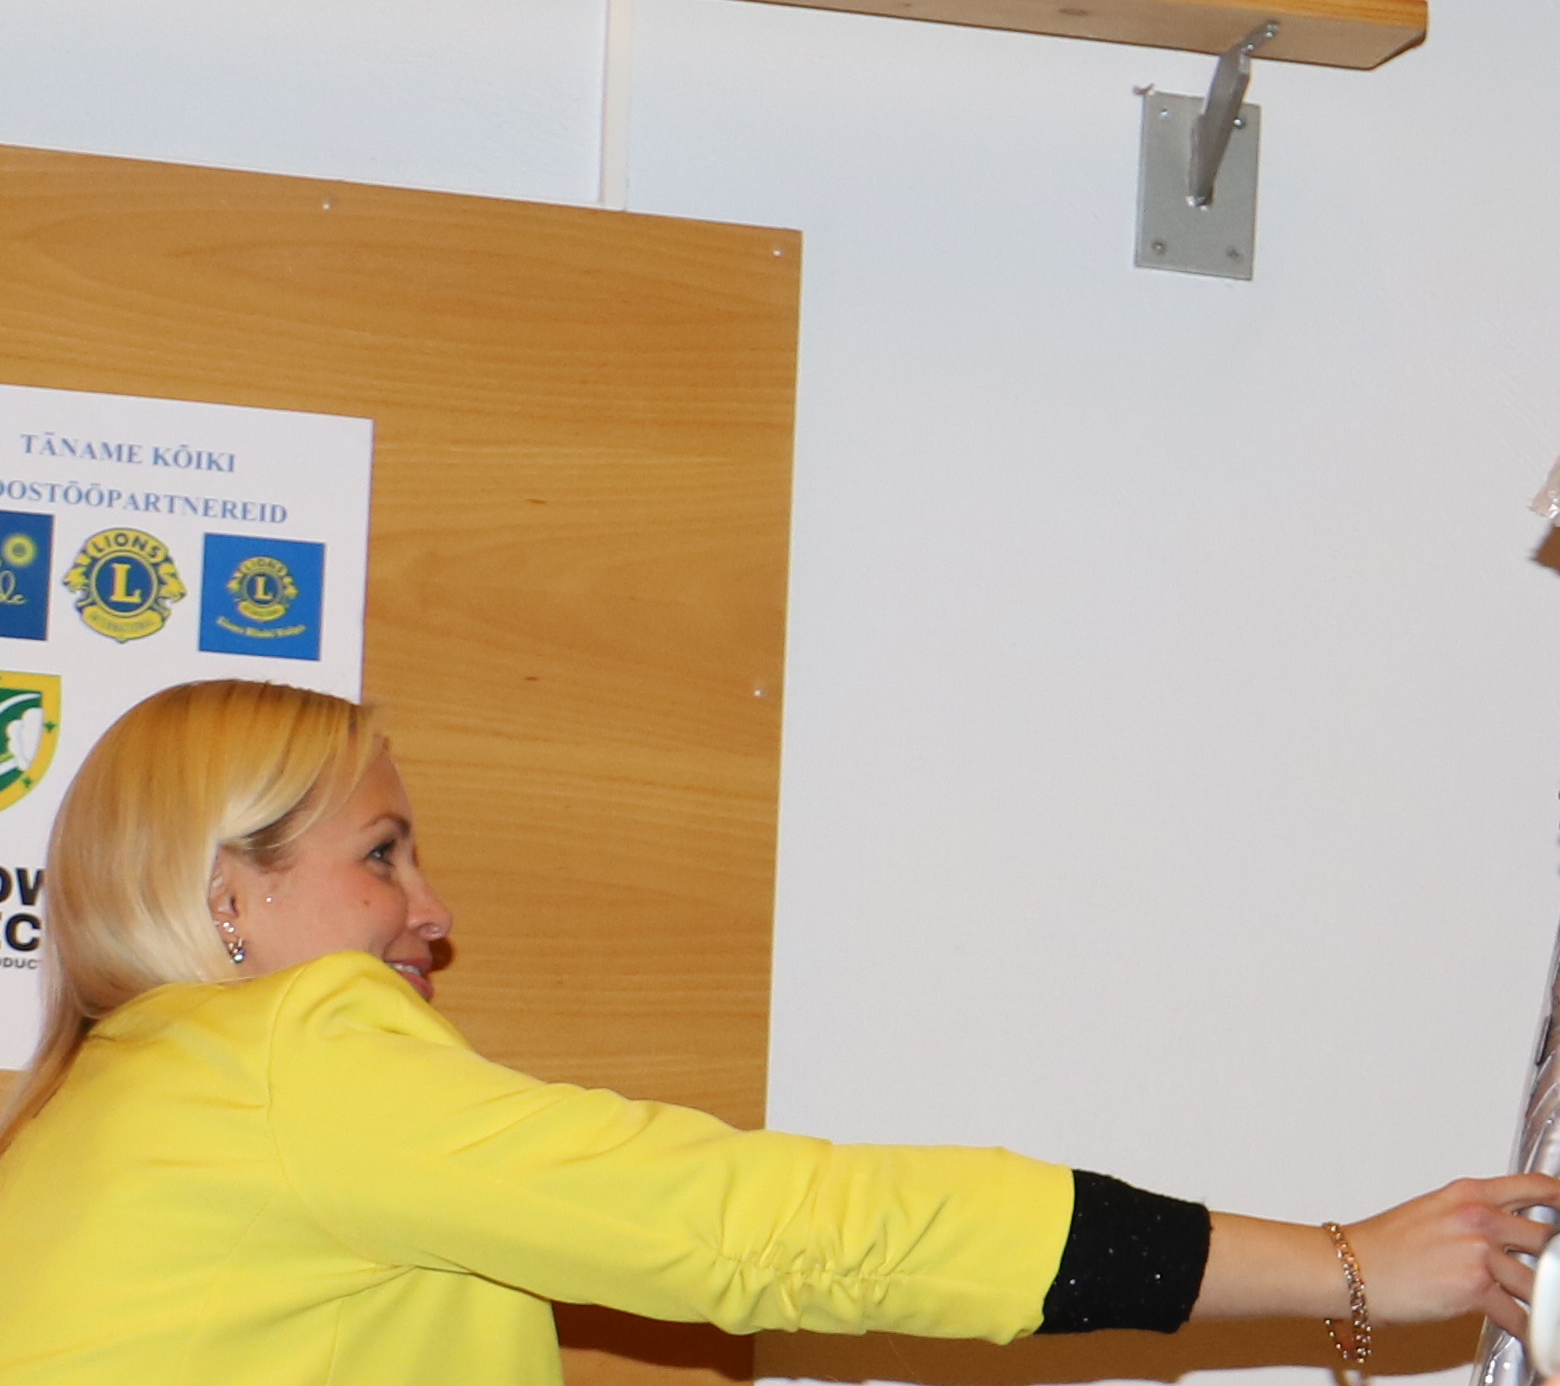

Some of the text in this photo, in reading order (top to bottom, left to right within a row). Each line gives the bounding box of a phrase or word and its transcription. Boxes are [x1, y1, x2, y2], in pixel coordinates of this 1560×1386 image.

[21, 431, 236, 473] TÄNAME KÕIKI
[92, 532, 162, 559] LIONS
[110, 562, 142, 603] L
